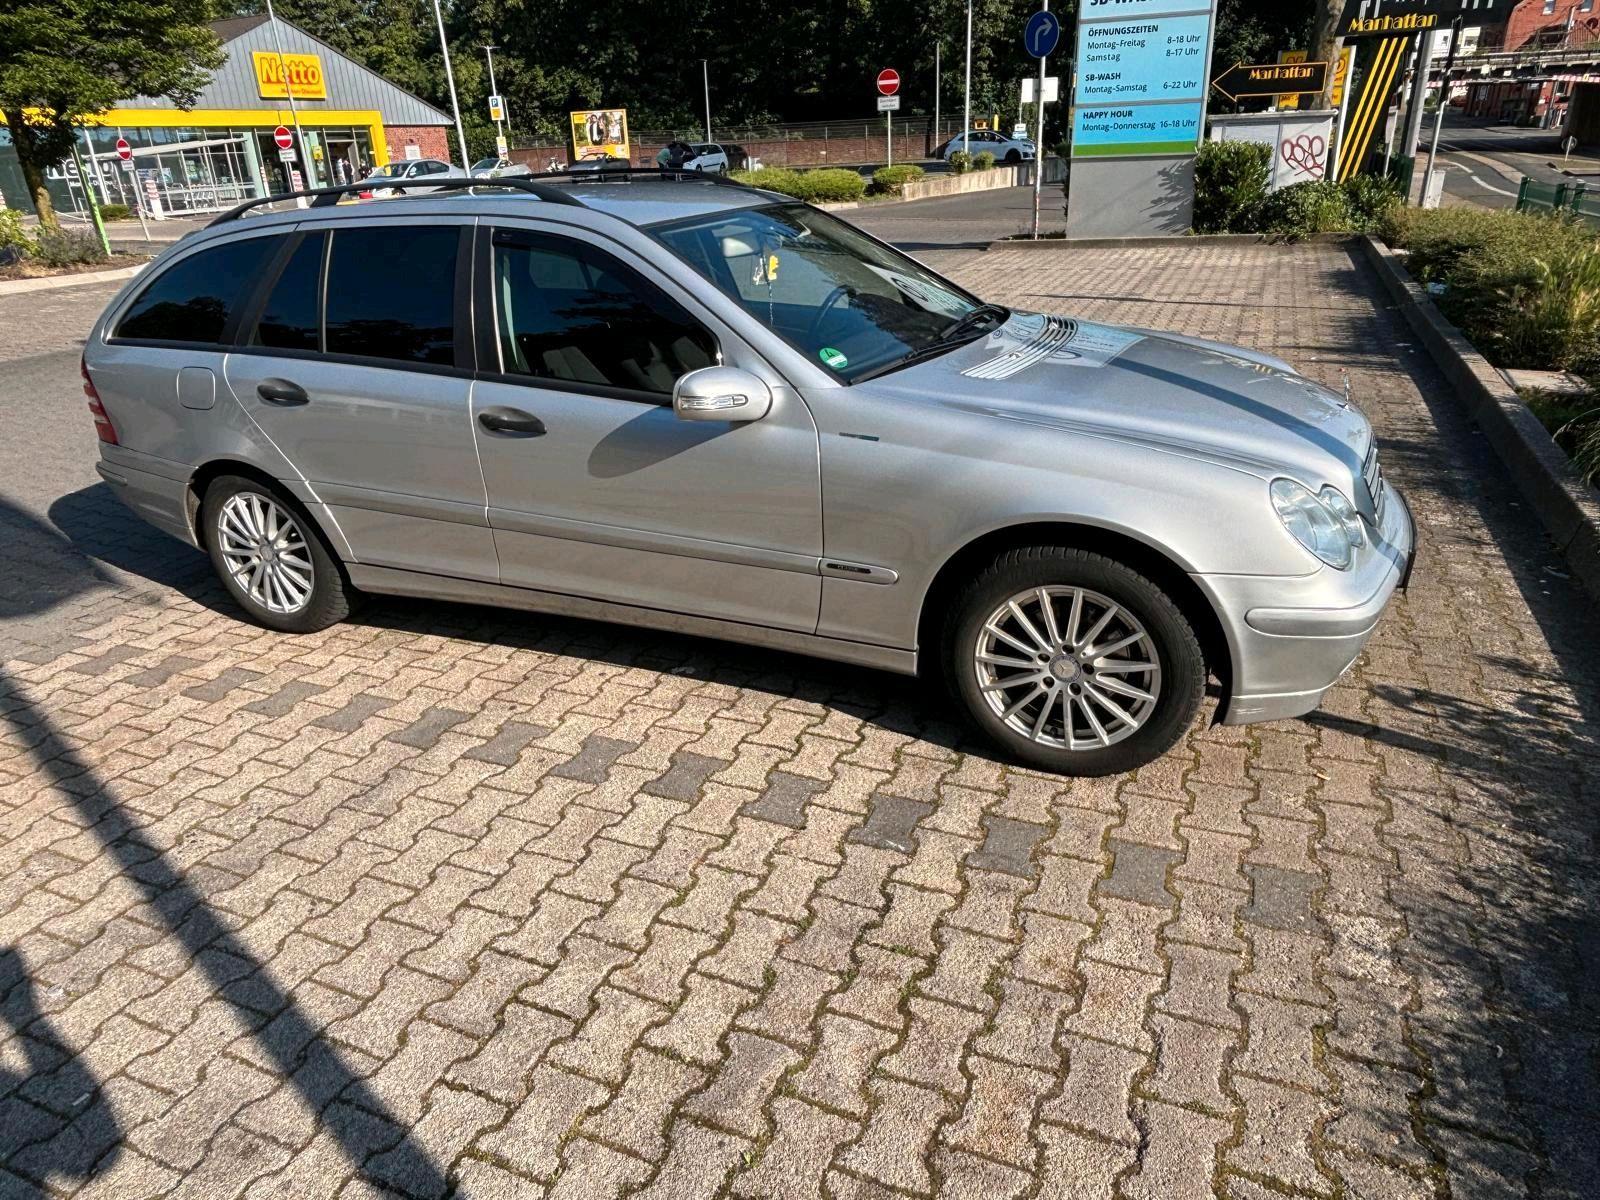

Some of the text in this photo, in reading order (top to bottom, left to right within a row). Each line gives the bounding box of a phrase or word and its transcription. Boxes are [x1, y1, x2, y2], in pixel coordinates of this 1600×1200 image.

[1348, 13, 1438, 32] Manhattan
[1088, 24, 1159, 37] ÖFFNUNGSZEITEN
[1186, 34, 1200, 43] Uhr
[1086, 53, 1121, 62] Samstag
[1185, 48, 1199, 56] Uhr
[260, 57, 320, 85] Netto
[1085, 72, 1121, 81] SB-WASH
[1249, 66, 1314, 80] Manhattan
[1183, 80, 1197, 89] Uhr
[1083, 110, 1133, 119] HAPPY HOUR
[1182, 119, 1196, 127] Uhr
